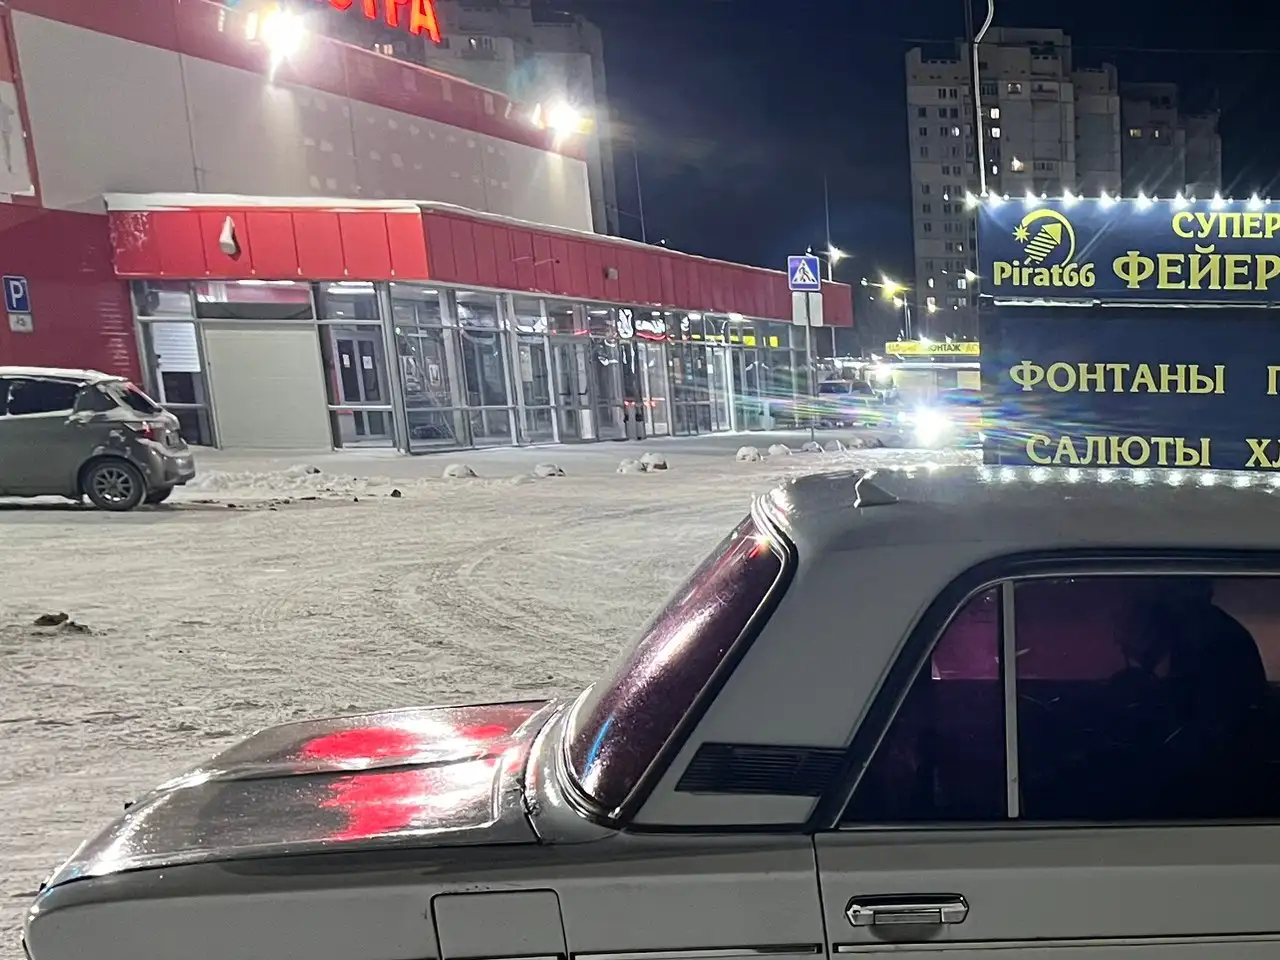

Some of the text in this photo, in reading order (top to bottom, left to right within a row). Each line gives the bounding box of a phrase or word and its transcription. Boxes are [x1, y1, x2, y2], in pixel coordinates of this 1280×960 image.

[993, 260, 1096, 287] Pirat66
[1009, 360, 1226, 394] ФОНТАНЫ
[1026, 435, 1211, 467] САЛЮТЫ
